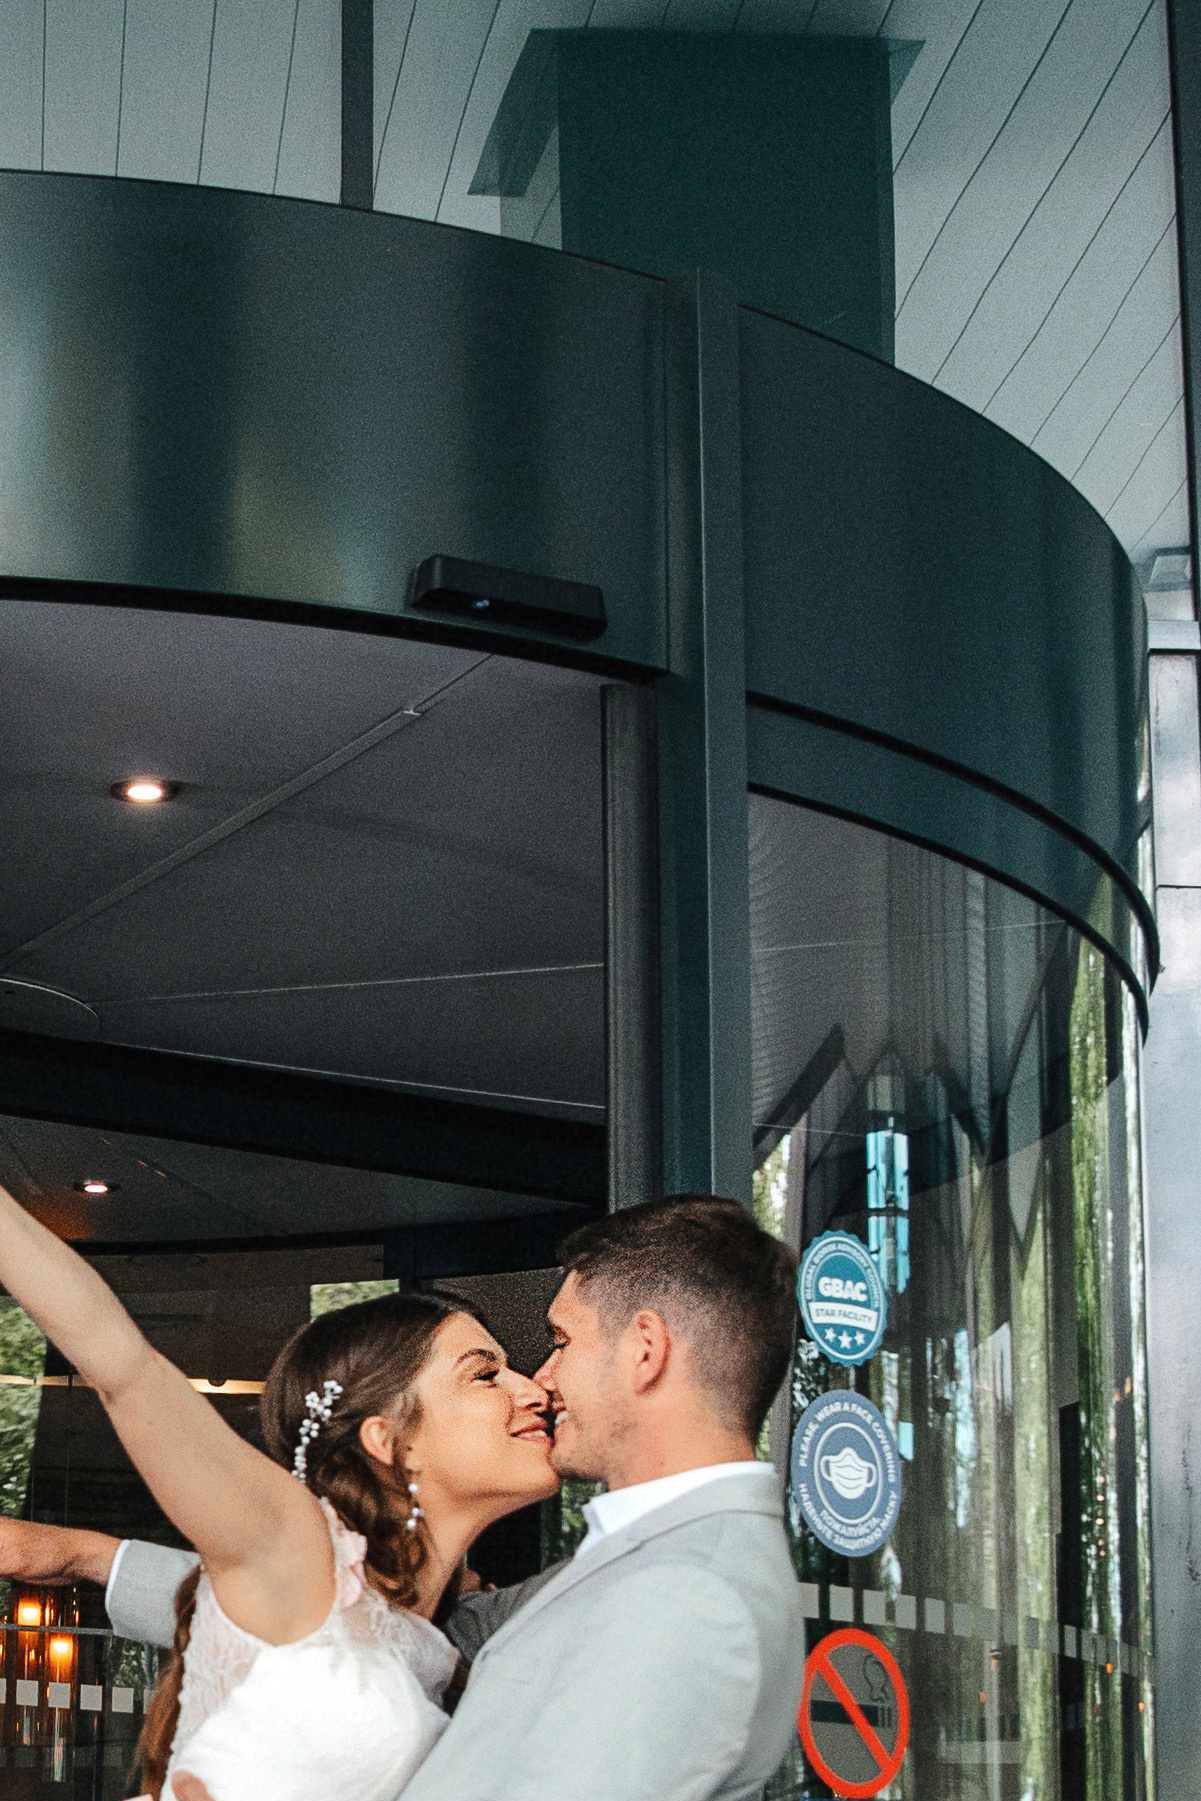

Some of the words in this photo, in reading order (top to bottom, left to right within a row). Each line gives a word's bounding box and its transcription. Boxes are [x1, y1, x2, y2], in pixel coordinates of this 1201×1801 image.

[818, 1276, 868, 1302] GBAC
[815, 1308, 836, 1318] STAR
[837, 1309, 873, 1323] FACILITY
[814, 1401, 842, 1422] WEAR
[842, 1402, 850, 1412] A
[850, 1402, 874, 1425] FACE
[872, 1421, 897, 1483] COVERING
